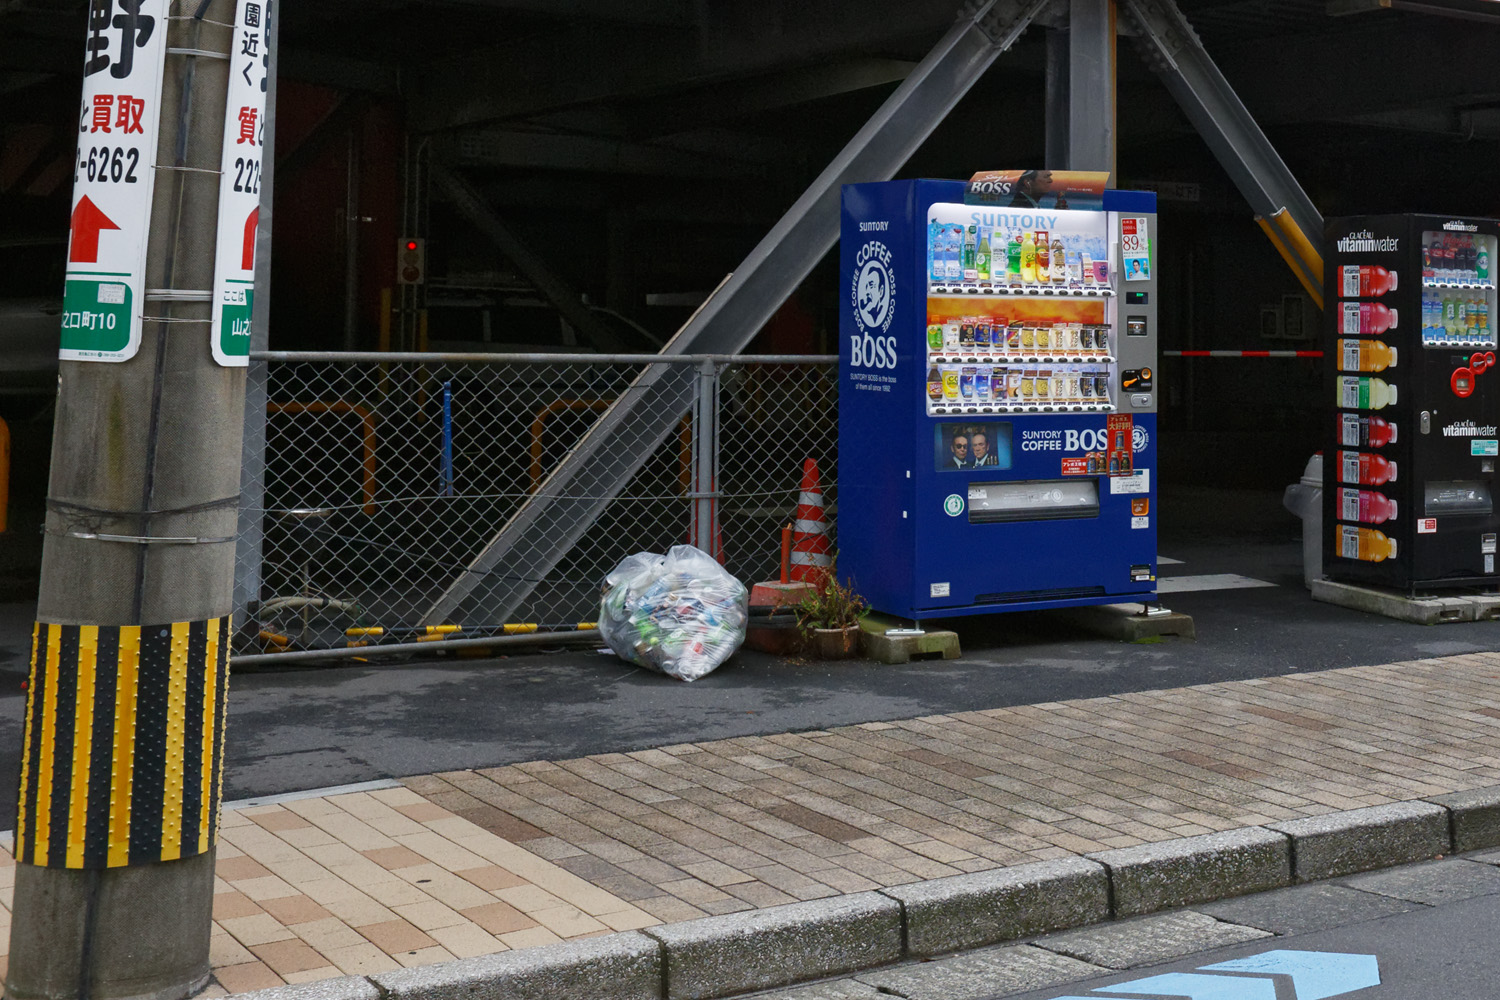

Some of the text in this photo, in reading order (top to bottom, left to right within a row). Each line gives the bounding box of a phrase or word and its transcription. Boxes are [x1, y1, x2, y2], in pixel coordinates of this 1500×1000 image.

[970, 181, 1011, 195] BOSS
[859, 221, 889, 232] SUNTORY
[971, 212, 1059, 229] SUNTORY
[1123, 235, 1139, 251] 89
[1337, 236, 1399, 252] vitaminwater
[856, 240, 893, 268] COFFEE
[850, 331, 897, 370] BOSS
[1022, 430, 1062, 439] SUNTORY
[1443, 425, 1497, 437] vitaminwater
[1021, 441, 1062, 451] COFFEE
[1064, 428, 1108, 451] BOS
